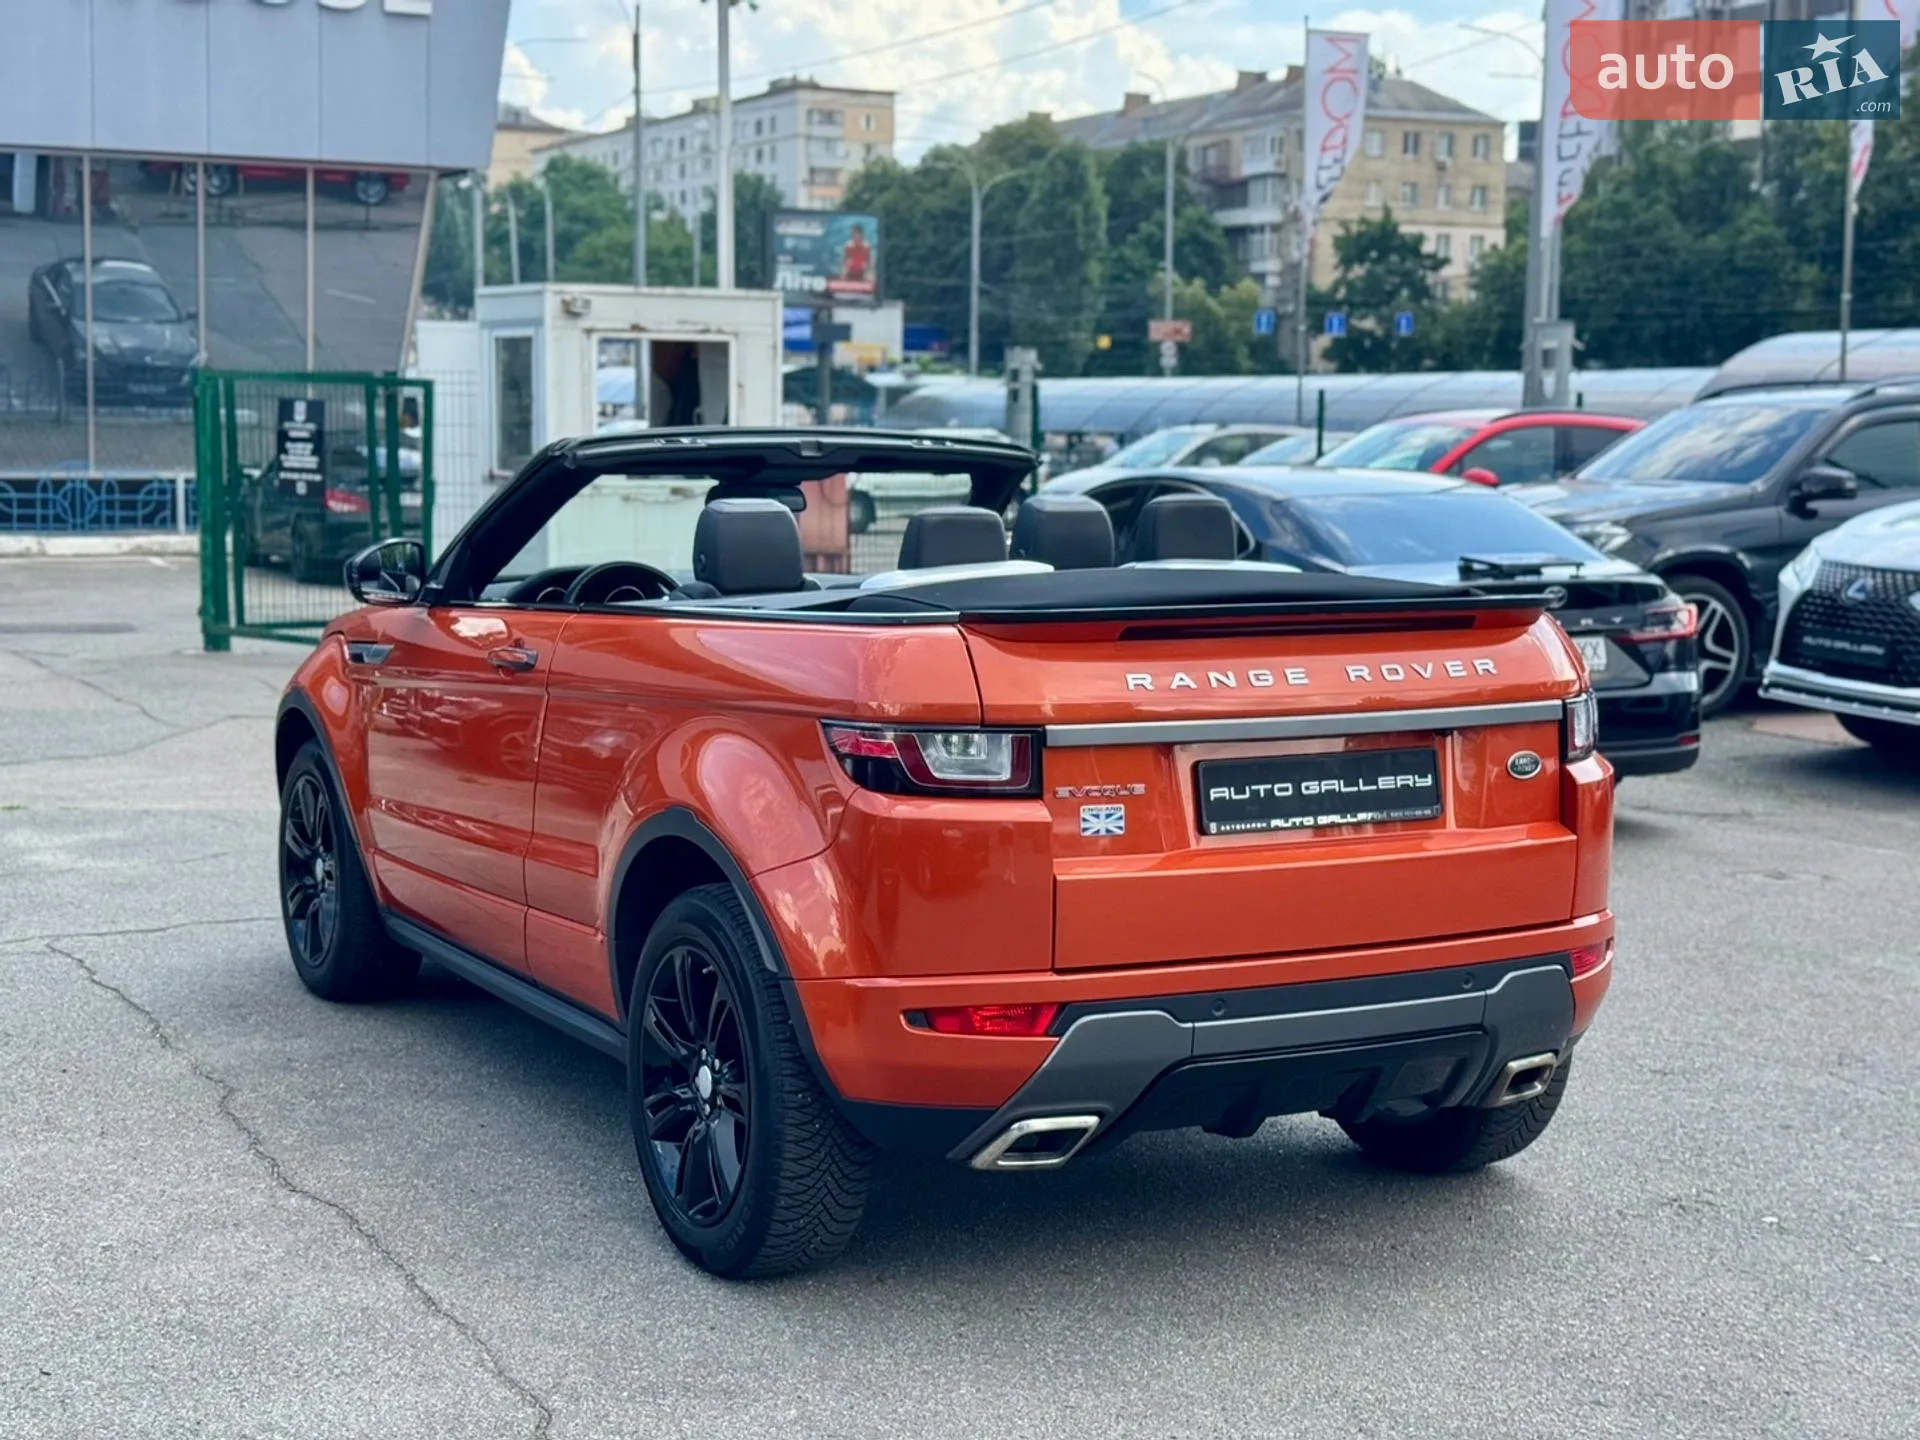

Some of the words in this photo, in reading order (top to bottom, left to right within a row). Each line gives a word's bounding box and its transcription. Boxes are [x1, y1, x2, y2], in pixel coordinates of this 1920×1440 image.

[1125, 667, 1310, 692] RANGE
[1344, 658, 1499, 683] ROVER
[1209, 783, 1294, 801] AUTO
[1301, 773, 1433, 795] GALLERY
[1270, 815, 1314, 828] AUTO
